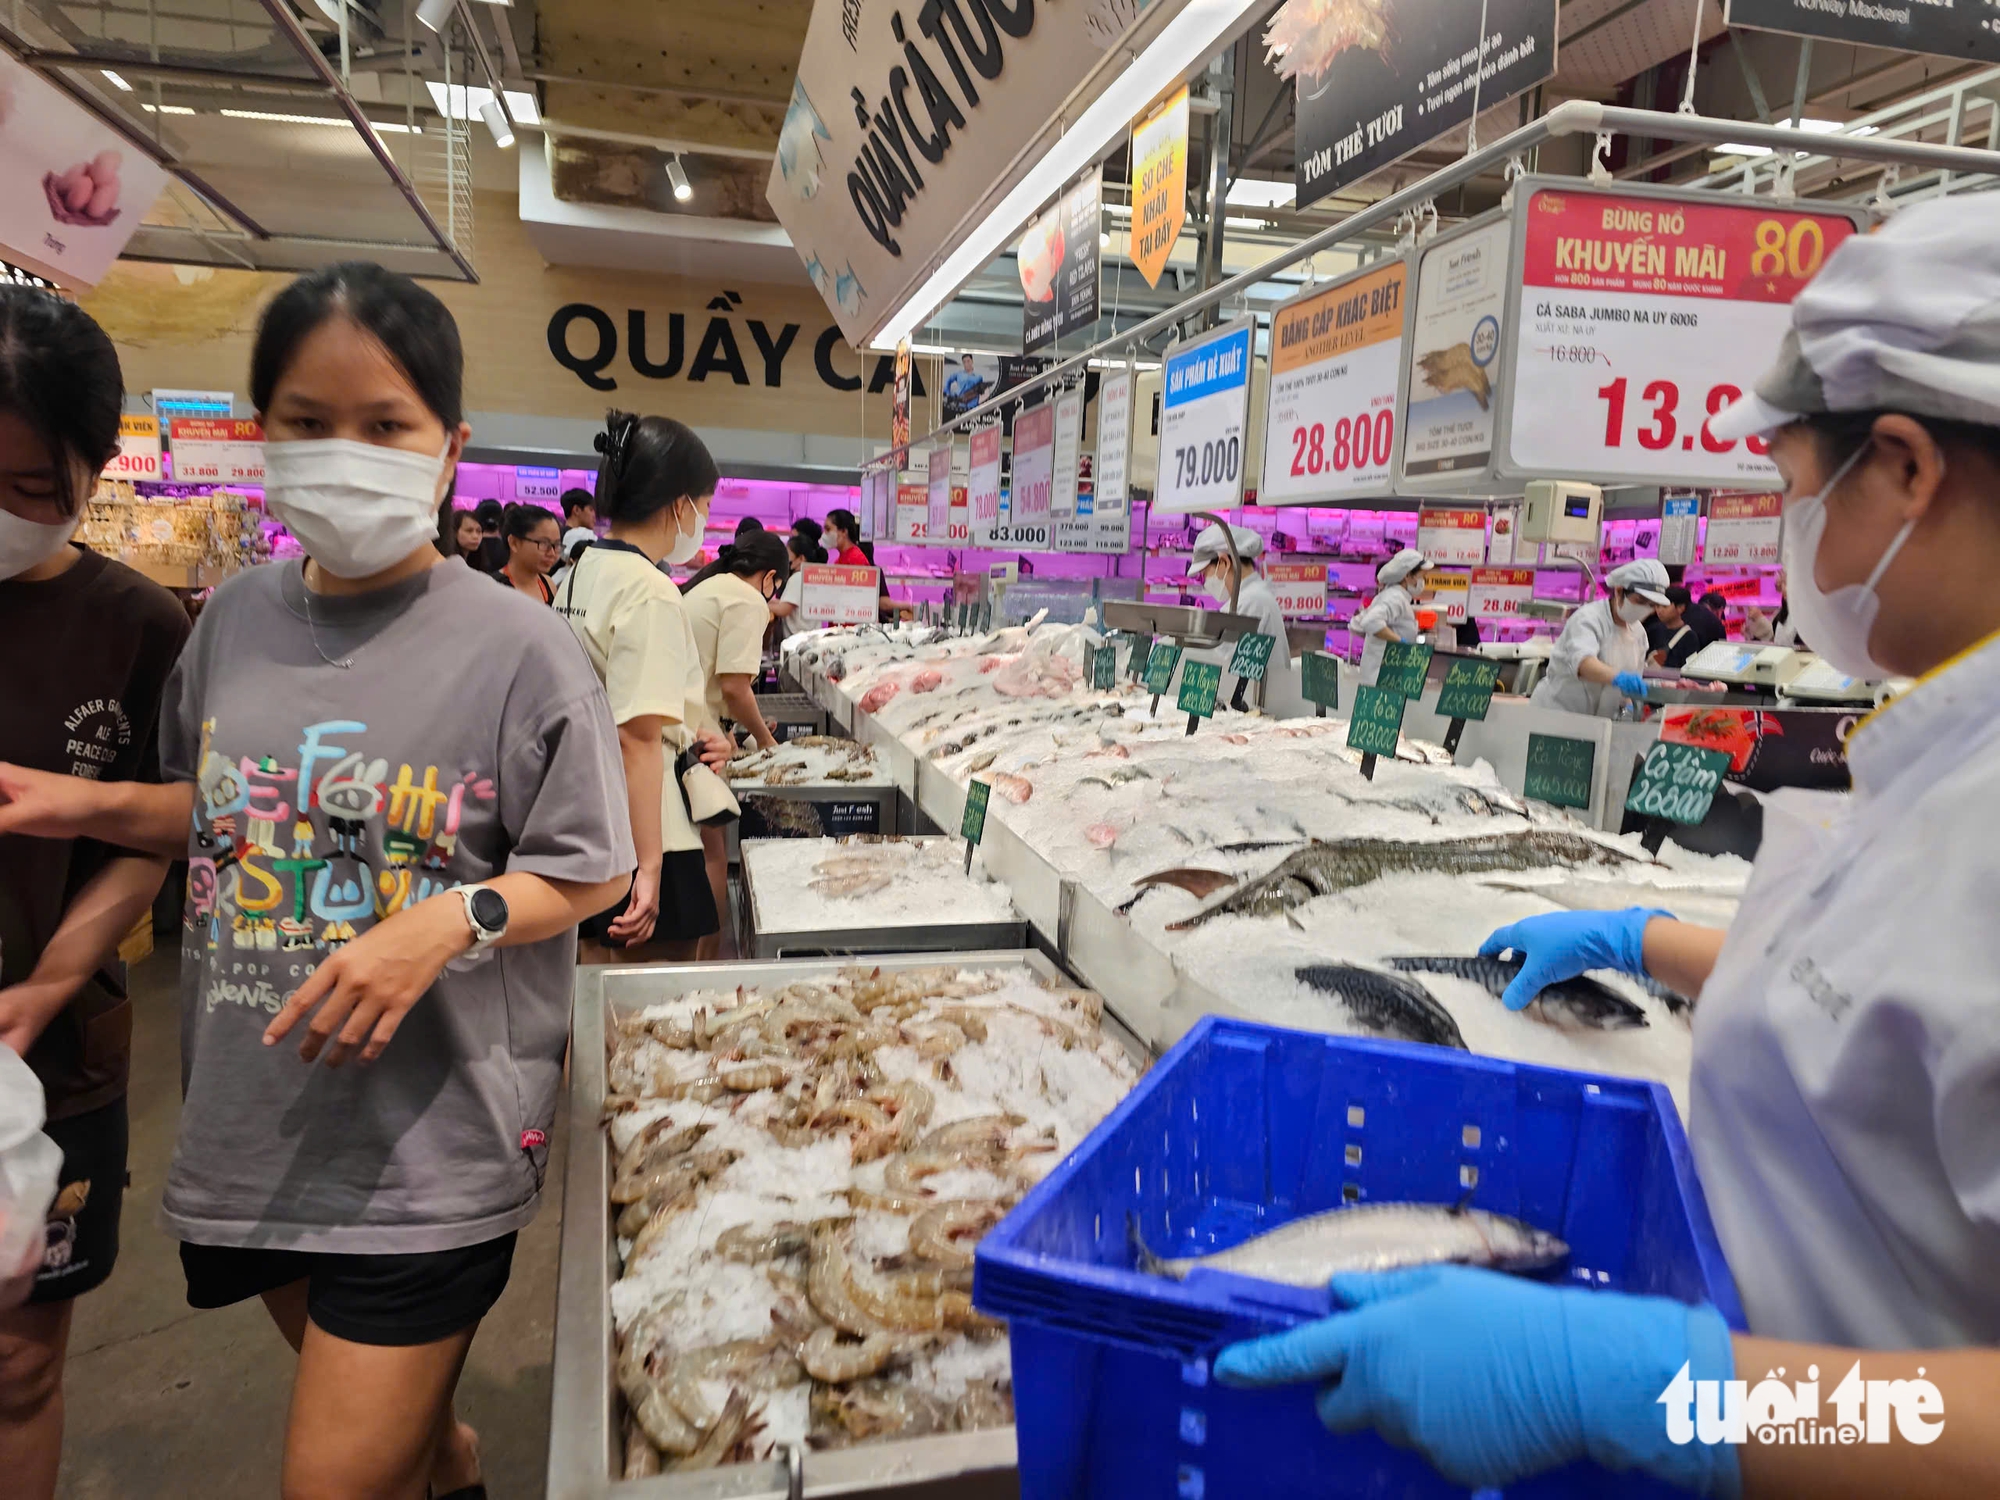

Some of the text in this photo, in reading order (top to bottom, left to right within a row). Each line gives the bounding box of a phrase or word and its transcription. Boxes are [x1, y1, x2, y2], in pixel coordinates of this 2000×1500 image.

[1849, 0, 1910, 24] Mackerel
[1427, 70, 1442, 89] Tôm
[1461, 46, 1479, 68] mua
[1491, 32, 1502, 50] ao
[1426, 90, 1444, 113] Tươi
[1444, 81, 1463, 104] ngon
[1497, 46, 1519, 72] đánh
[1303, 103, 1403, 184] TÔM THẺ TƯƠI
[847, 85, 925, 258] QUẦY
[1156, 145, 1175, 184] CHẾ
[1143, 188, 1168, 226] NHẬN
[1602, 205, 1685, 236] BÙNG NỔ
[1139, 218, 1173, 264] TẠI ĐÂY
[1555, 235, 1726, 281] KHUYẾN MÃI
[1750, 218, 1824, 280] 80
[1570, 272, 1590, 286] 800
[1652, 276, 1667, 291] 80
[1281, 278, 1401, 349] ĐẲNG CẤP KHÁC BIỆT
[1536, 300, 1698, 327] CÁ SABA JUMBO NA UY 600G
[546, 290, 801, 391] QUẦY
[1550, 344, 1596, 364] 16.800
[234, 421, 256, 436] 80
[1290, 408, 1394, 477] 28.800
[1175, 436, 1240, 490] 79.000
[524, 485, 558, 496] 52.500
[1462, 512, 1479, 526] 80
[851, 569, 869, 583] 80
[64, 699, 105, 732] ALFAER
[65, 739, 101, 761] PEACE
[832, 804, 848, 815] Just
[232, 962, 270, 976] POP
